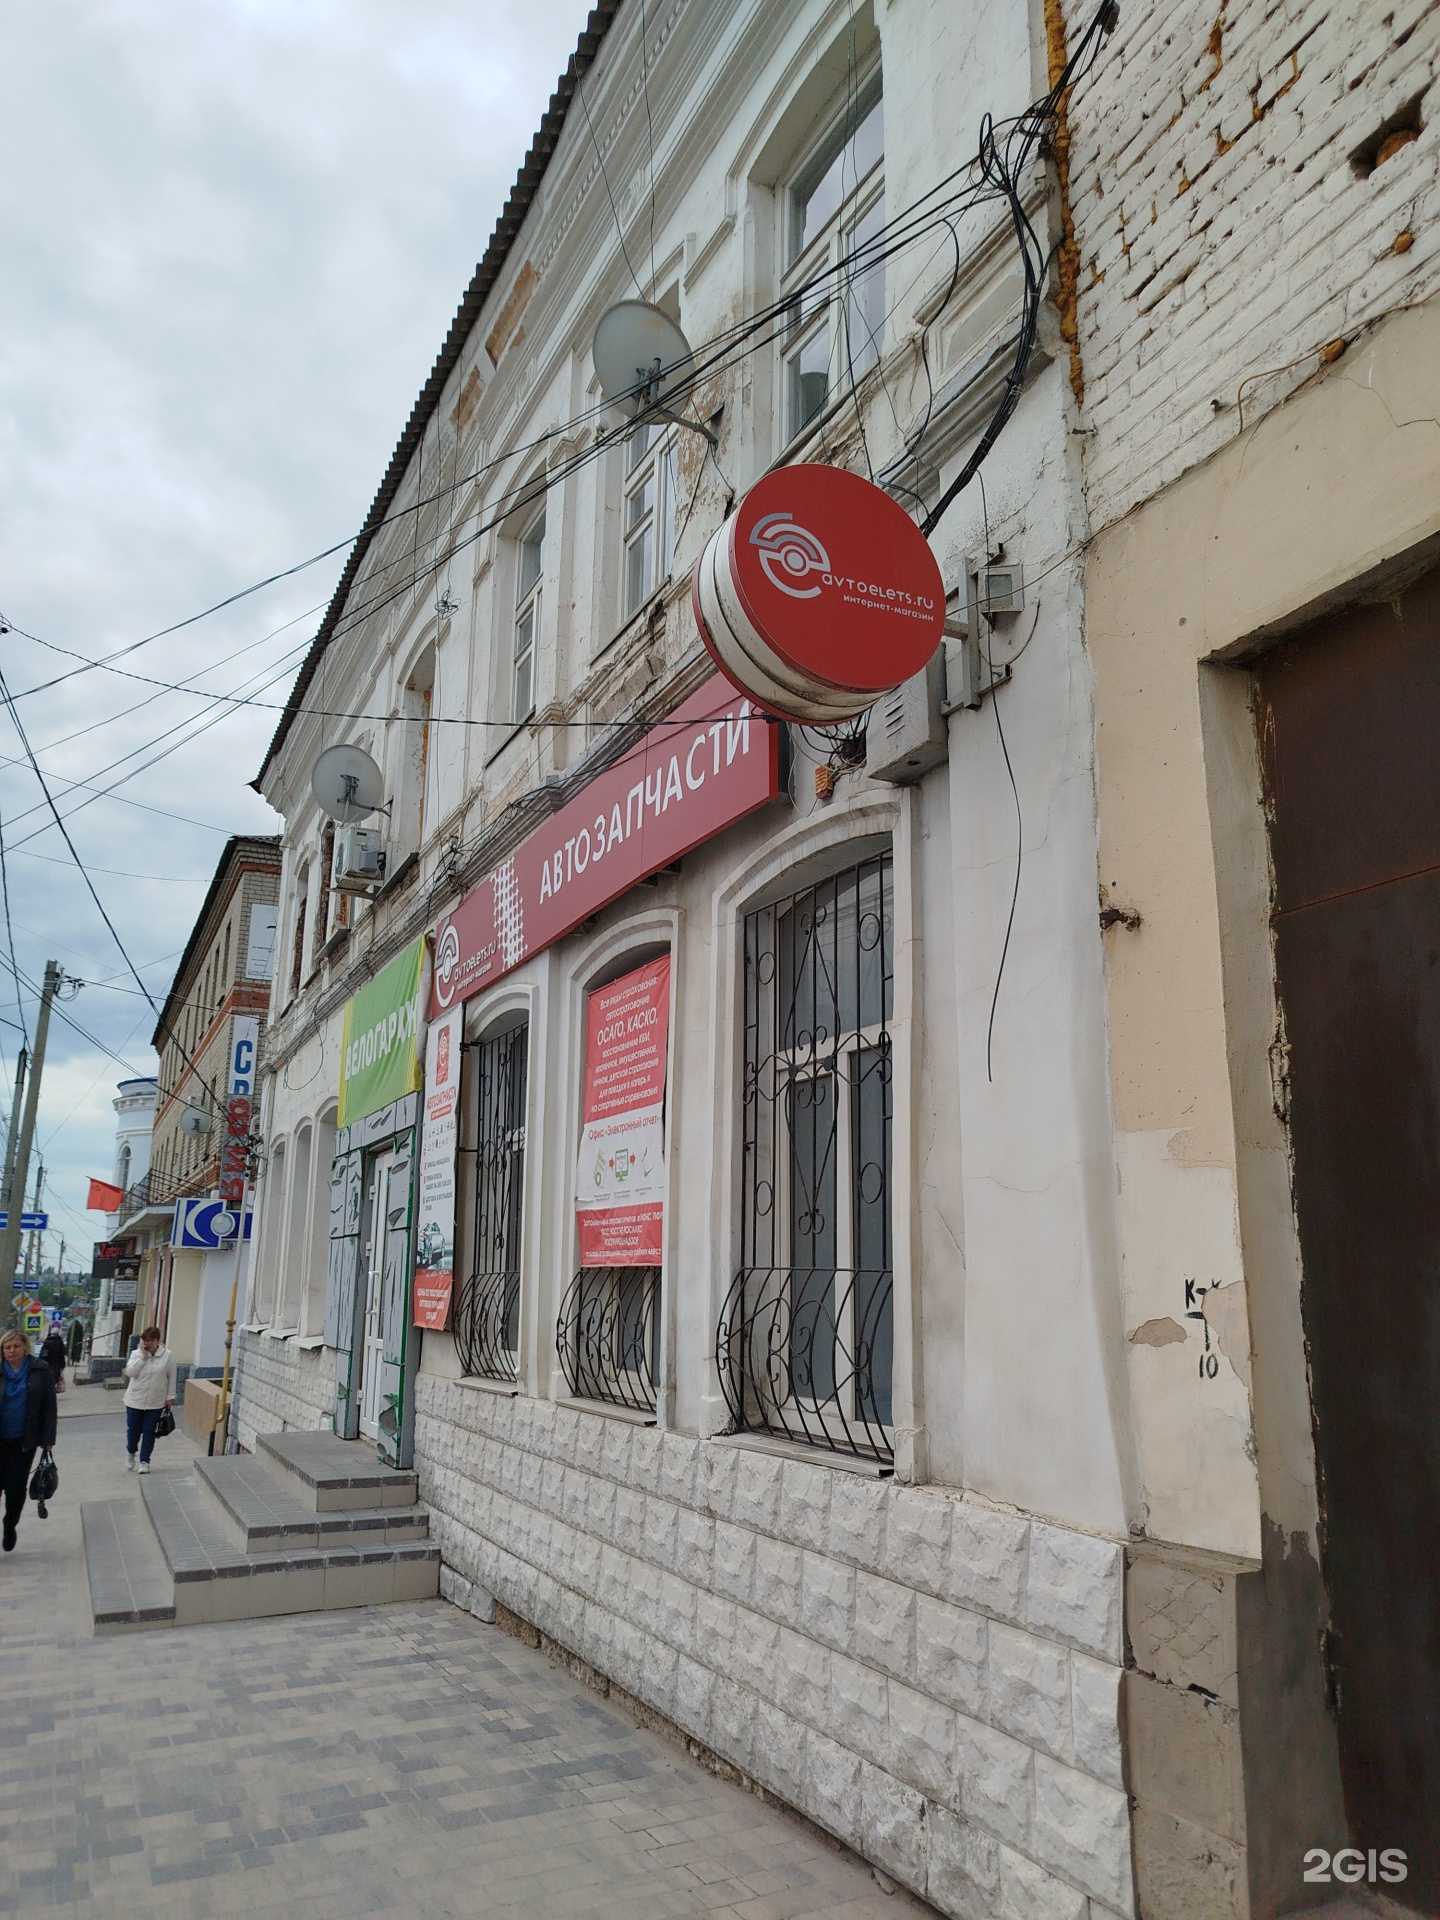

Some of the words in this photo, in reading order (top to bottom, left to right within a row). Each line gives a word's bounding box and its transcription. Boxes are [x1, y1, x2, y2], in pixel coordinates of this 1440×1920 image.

[539, 699, 750, 904] АВТОЗАПЧАСТИ
[597, 1020, 625, 1046] ОСАГО,
[627, 1007, 657, 1033] КАСКО,
